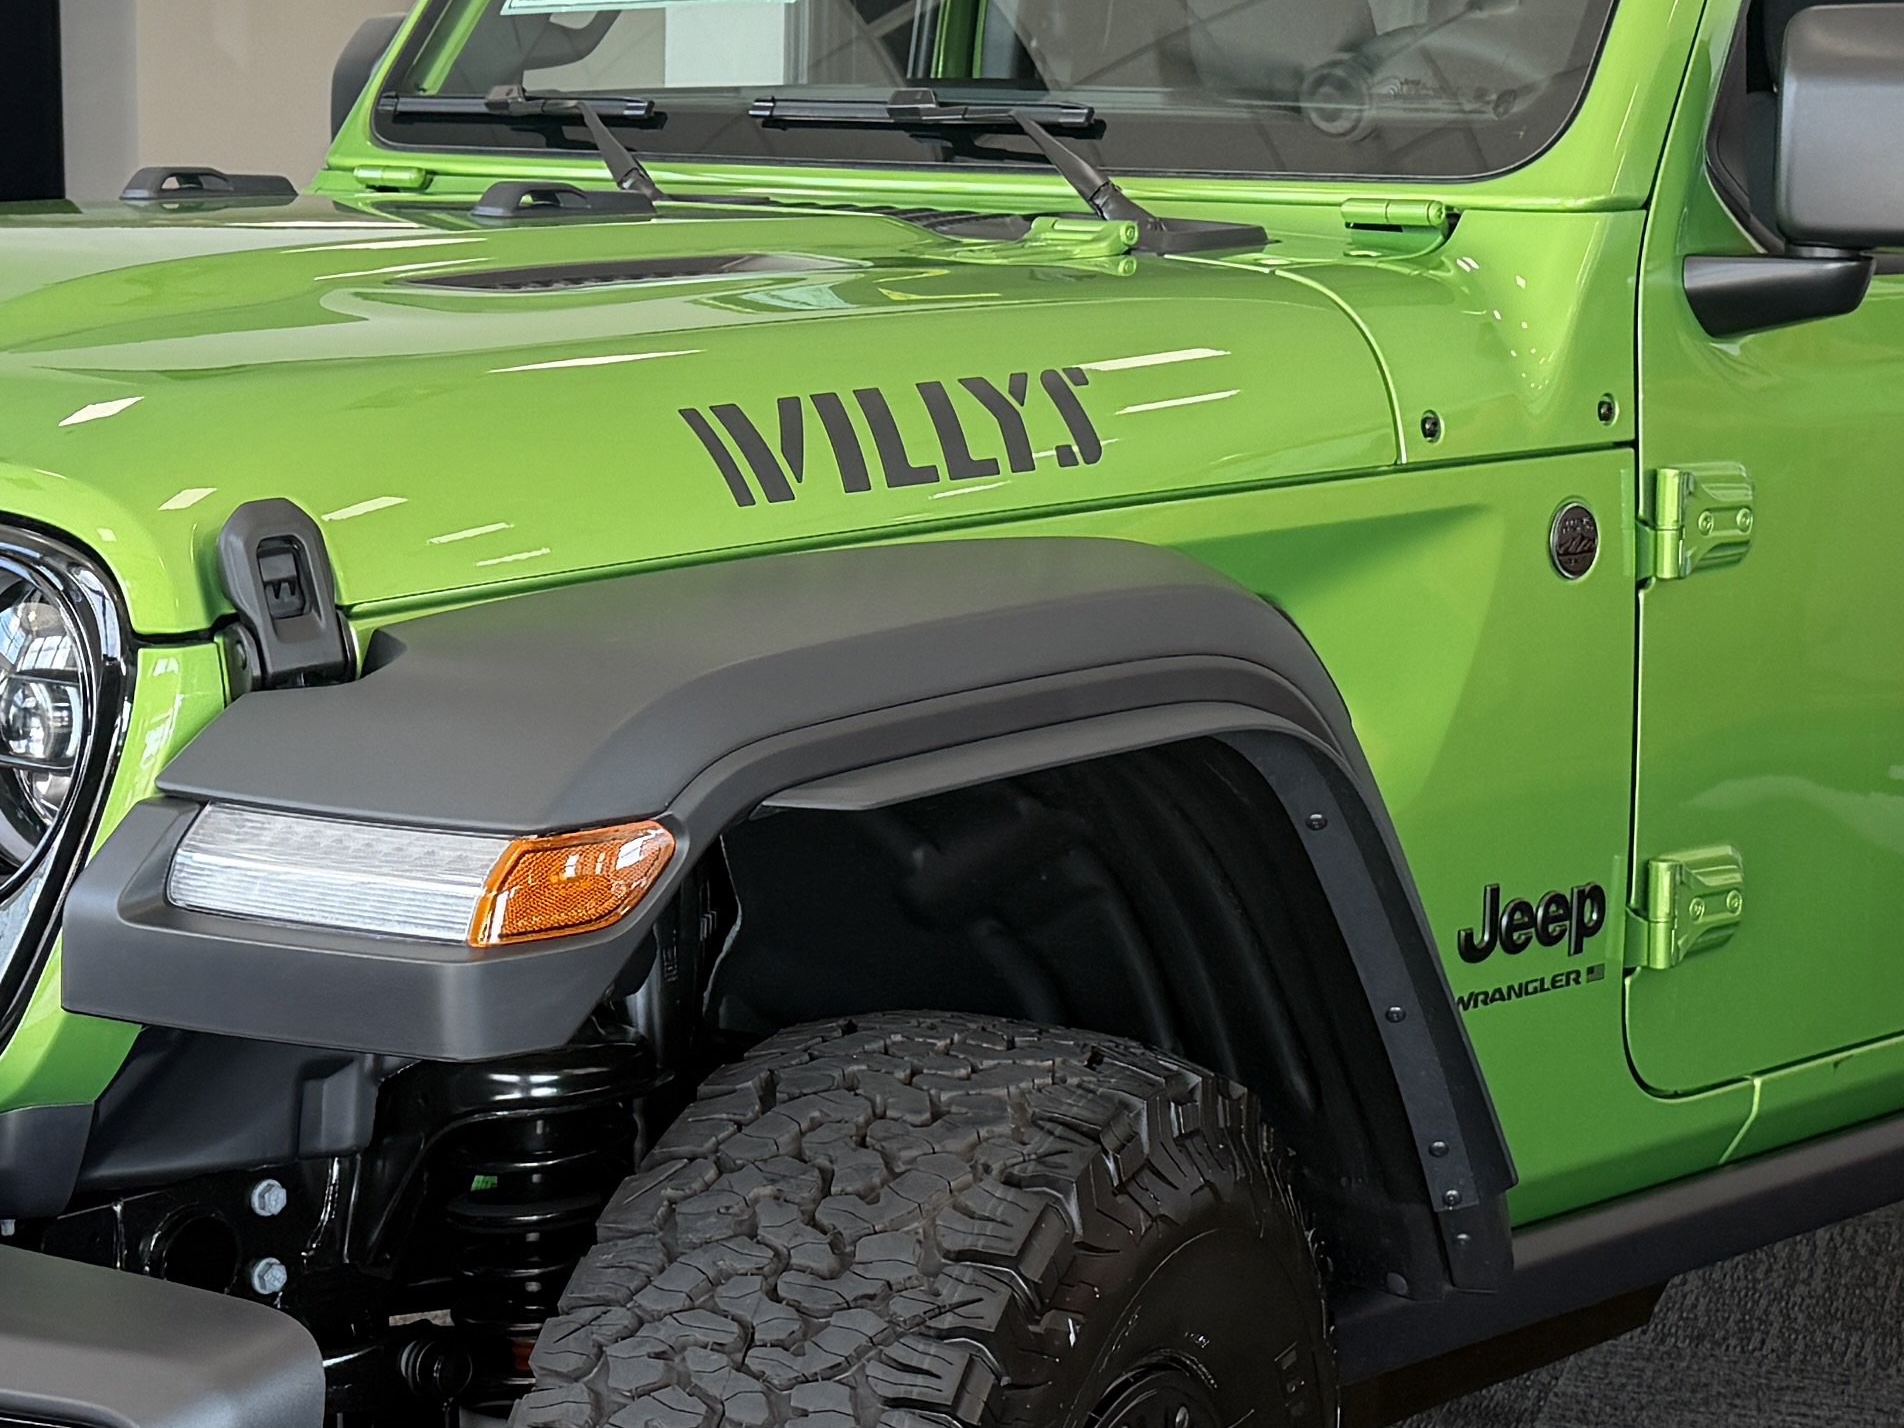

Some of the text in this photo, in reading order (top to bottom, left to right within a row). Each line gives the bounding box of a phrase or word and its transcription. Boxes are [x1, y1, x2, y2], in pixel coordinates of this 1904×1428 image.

[678, 366, 1104, 508] WILLYS
[1457, 880, 1607, 964] Jeep
[1456, 968, 1582, 1013] WRANGLER
